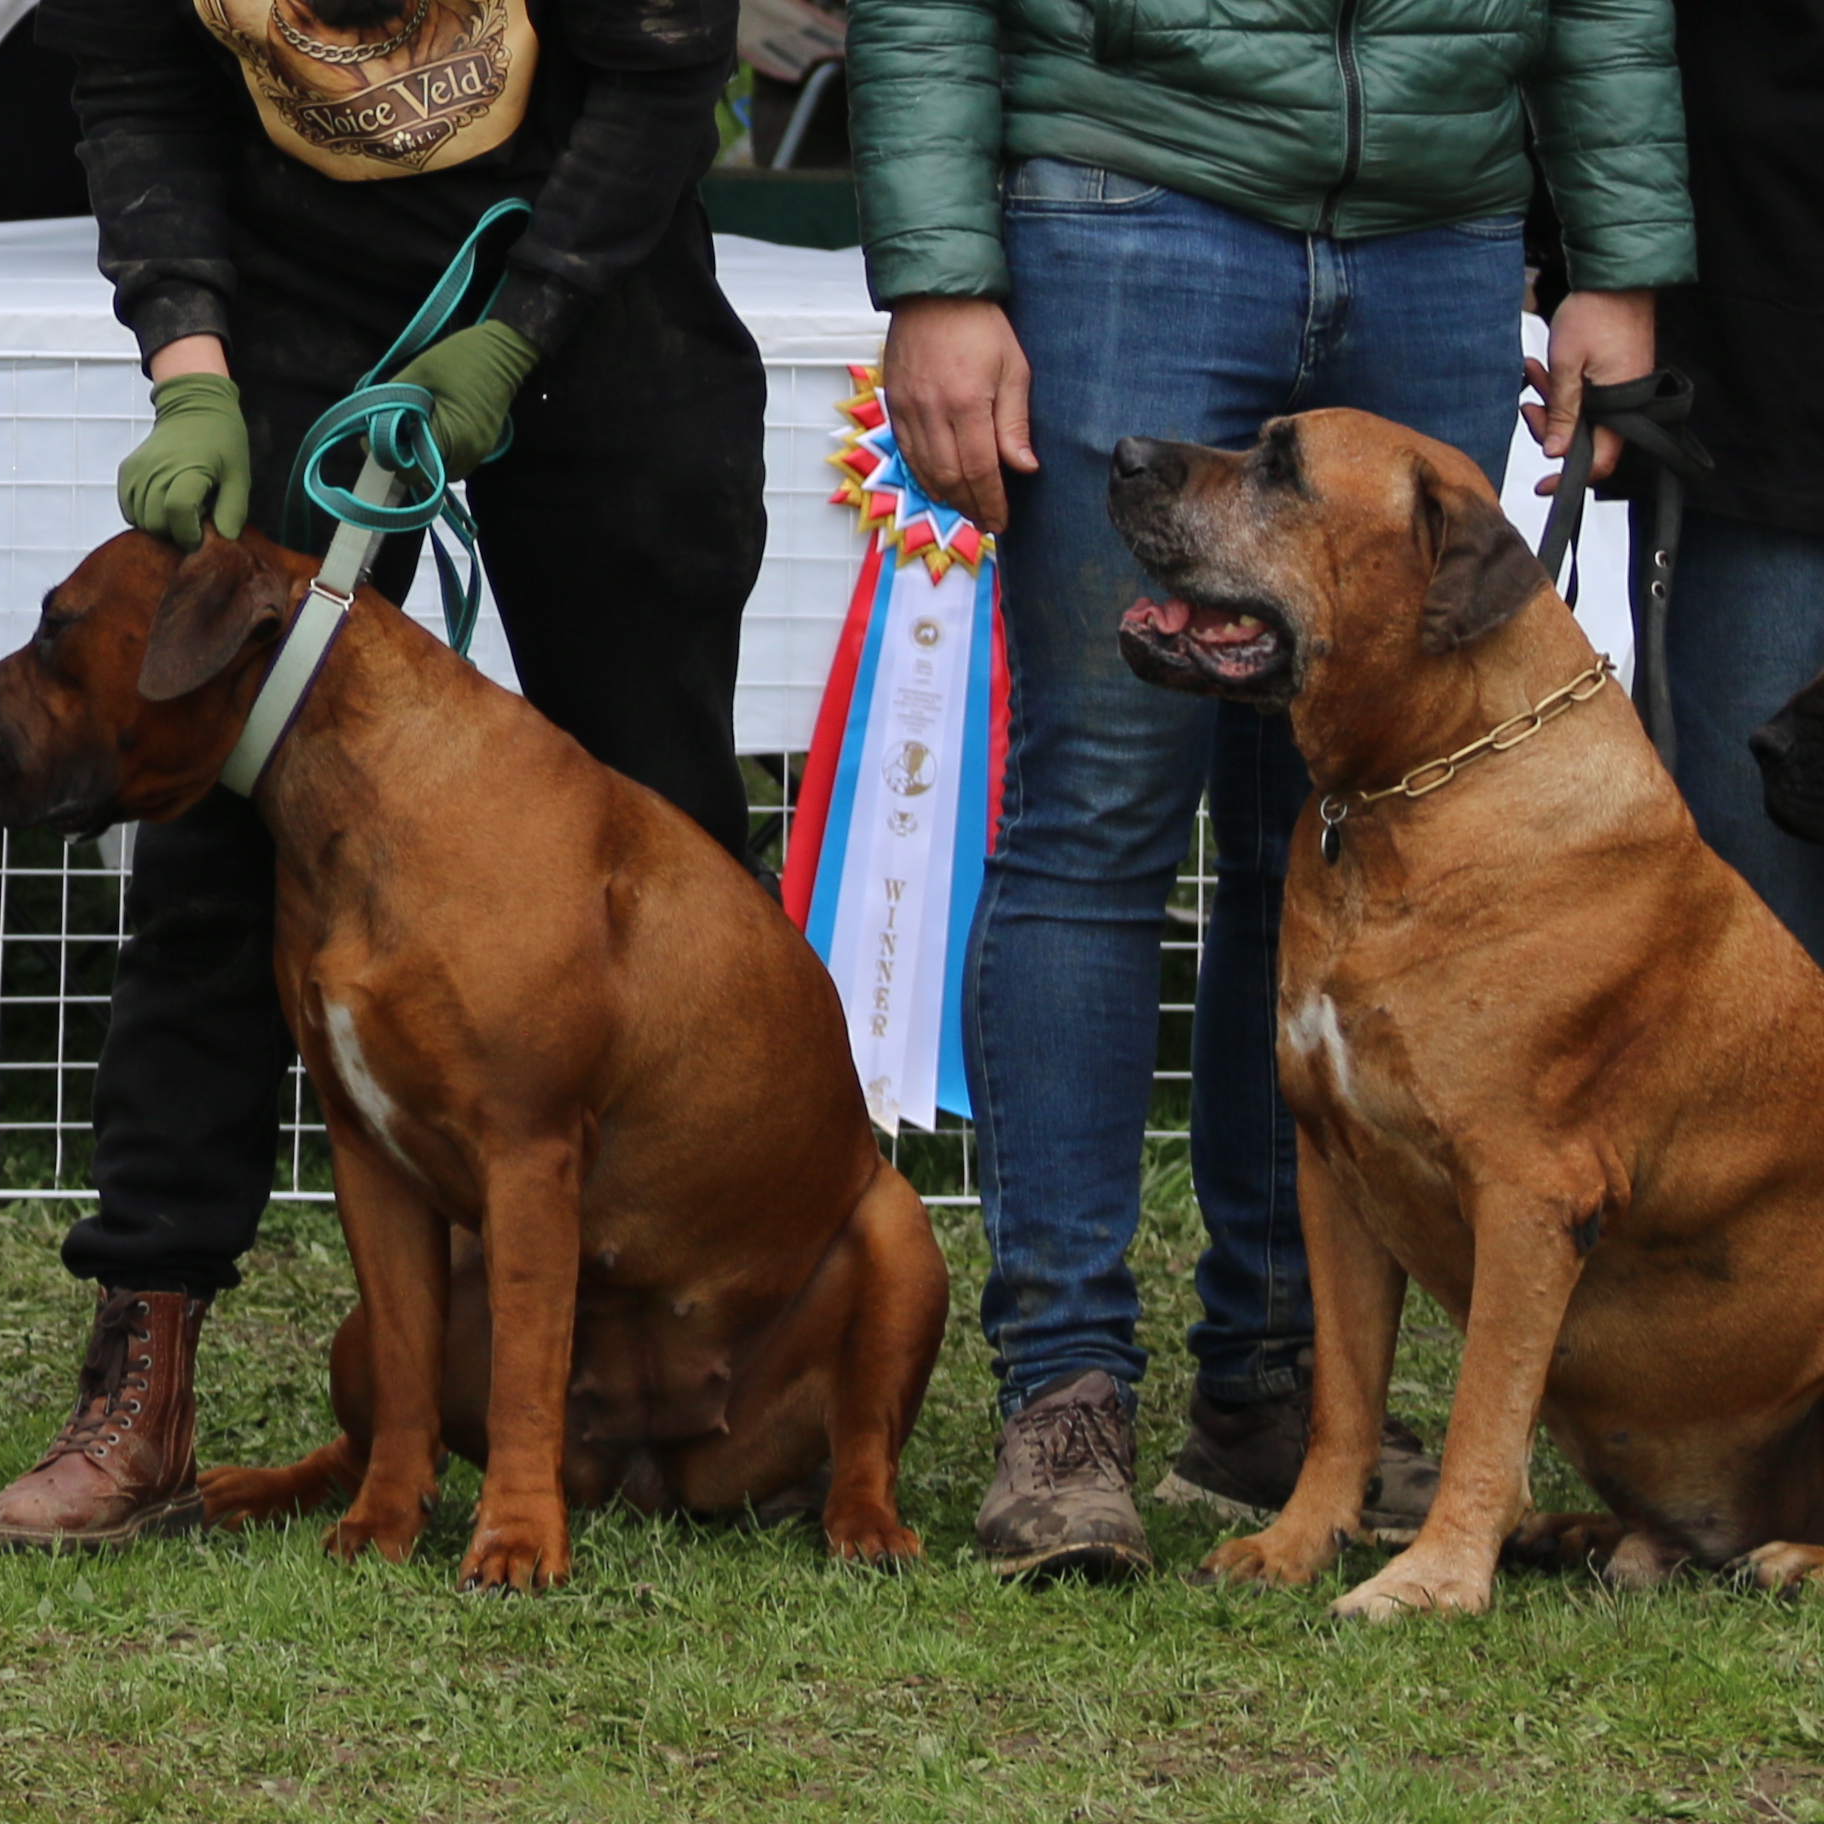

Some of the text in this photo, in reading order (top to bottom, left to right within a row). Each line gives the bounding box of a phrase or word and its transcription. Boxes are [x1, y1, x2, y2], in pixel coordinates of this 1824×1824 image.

[303, 60, 484, 136] Voice Veld
[870, 878, 907, 1038] WINNER
